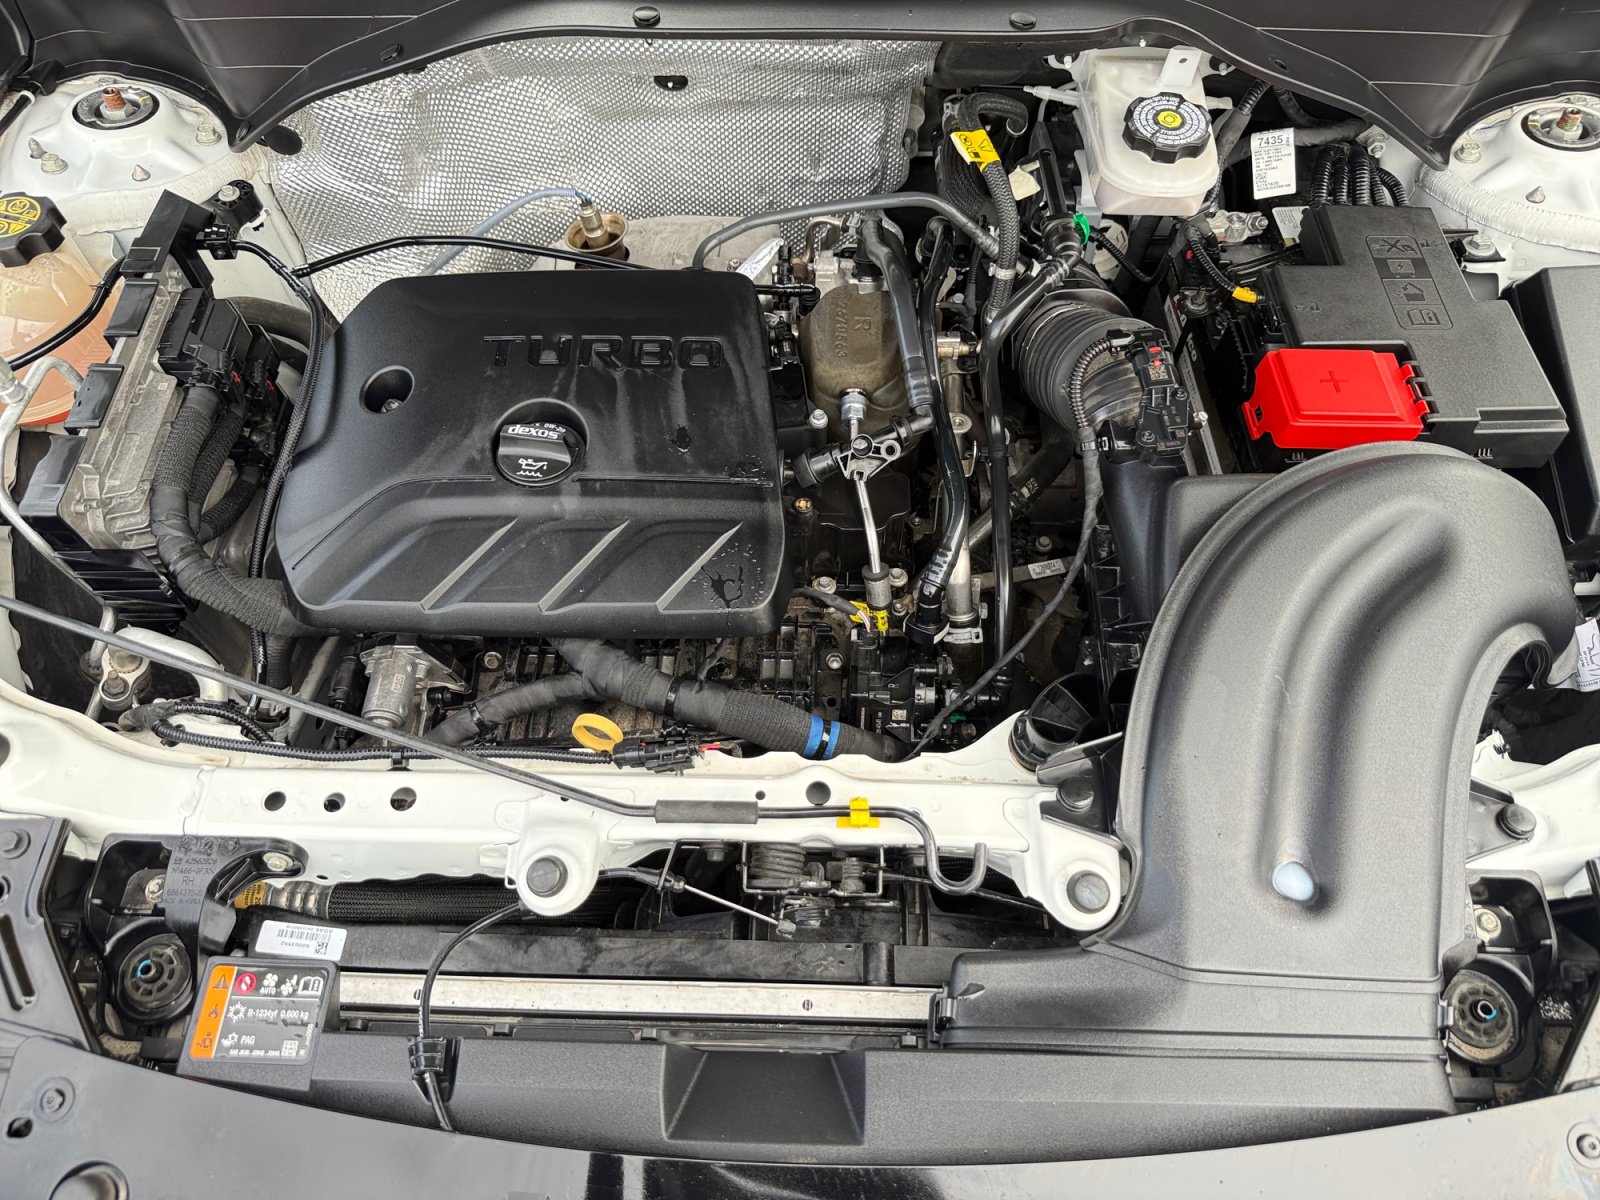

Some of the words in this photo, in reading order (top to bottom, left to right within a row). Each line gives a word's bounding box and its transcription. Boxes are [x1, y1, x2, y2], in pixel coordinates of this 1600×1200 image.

[1257, 134, 1284, 147] 7435
[854, 316, 872, 331] R
[483, 335, 722, 368] TURBO
[507, 425, 561, 440] dexos
[181, 876, 194, 886] RH
[260, 986, 276, 996] AUTO
[247, 1009, 278, 1018] R-1234yf
[280, 1009, 299, 1018] 0.600
[300, 1010, 309, 1019] kg
[240, 1035, 255, 1045] PAG
